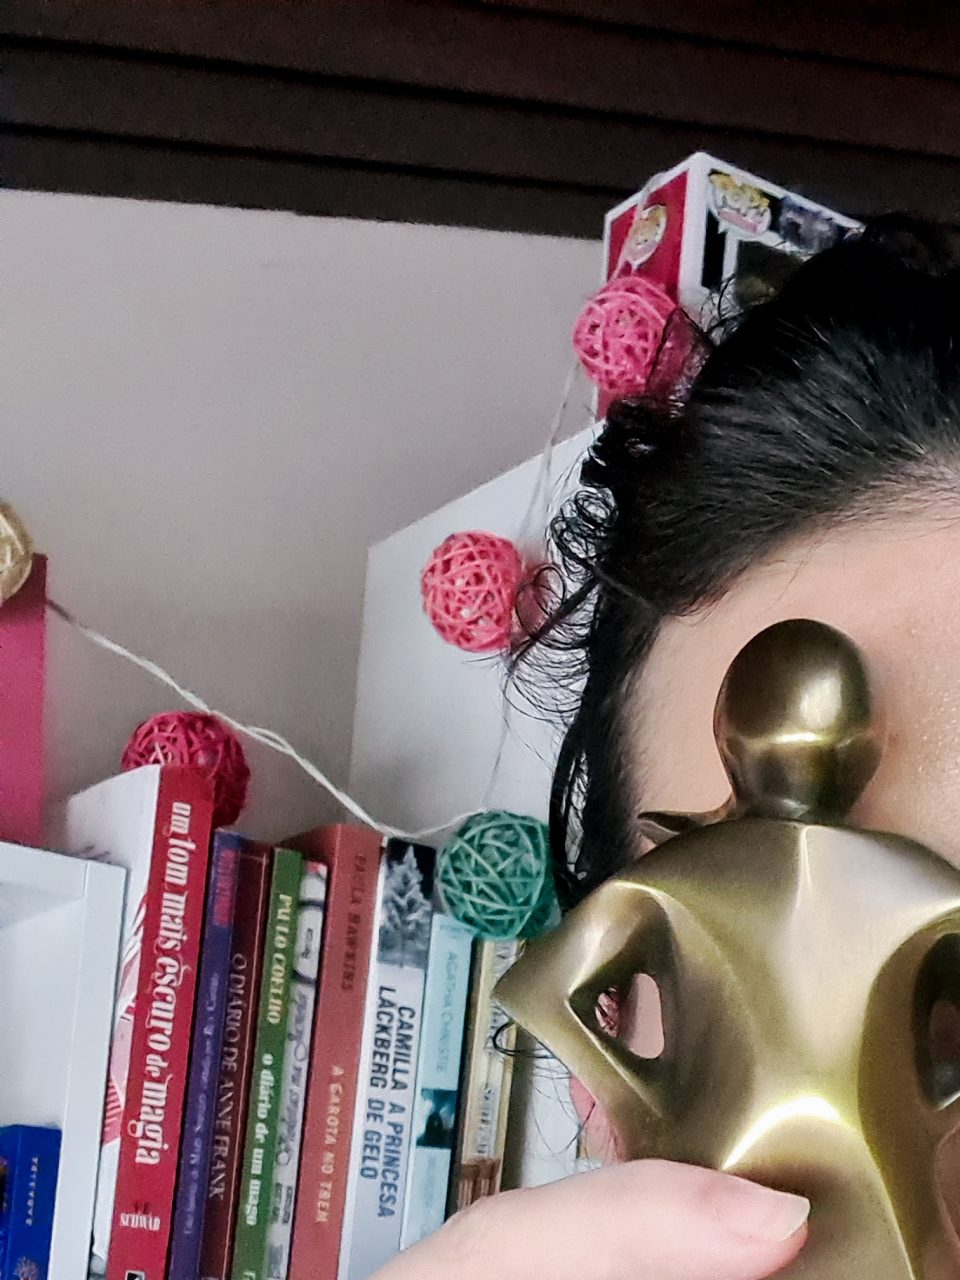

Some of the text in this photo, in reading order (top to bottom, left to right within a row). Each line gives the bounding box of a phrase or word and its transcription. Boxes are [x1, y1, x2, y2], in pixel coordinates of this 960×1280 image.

[163, 801, 191, 836] um
[164, 837, 197, 890] tom
[154, 891, 188, 956] mais
[232, 953, 248, 970] O
[266, 953, 287, 1025] COELHO
[145, 955, 192, 1052] escuro
[145, 1053, 169, 1078] de
[221, 1047, 239, 1073] DE
[261, 1053, 274, 1065] o
[369, 985, 397, 1090] LACKBERG
[391, 1006, 416, 1092] CAMILLA
[127, 1074, 174, 1166] magia
[215, 1080, 234, 1132] ANNE
[254, 1122, 270, 1144] de
[208, 1135, 231, 1200] FRANK
[251, 1147, 264, 1175] um
[315, 1065, 345, 1224] A GAROTA NO TREM
[360, 1098, 386, 1180] DE GELO
[377, 1102, 405, 1219] A PRINCESA
[245, 1177, 262, 1226] mago
